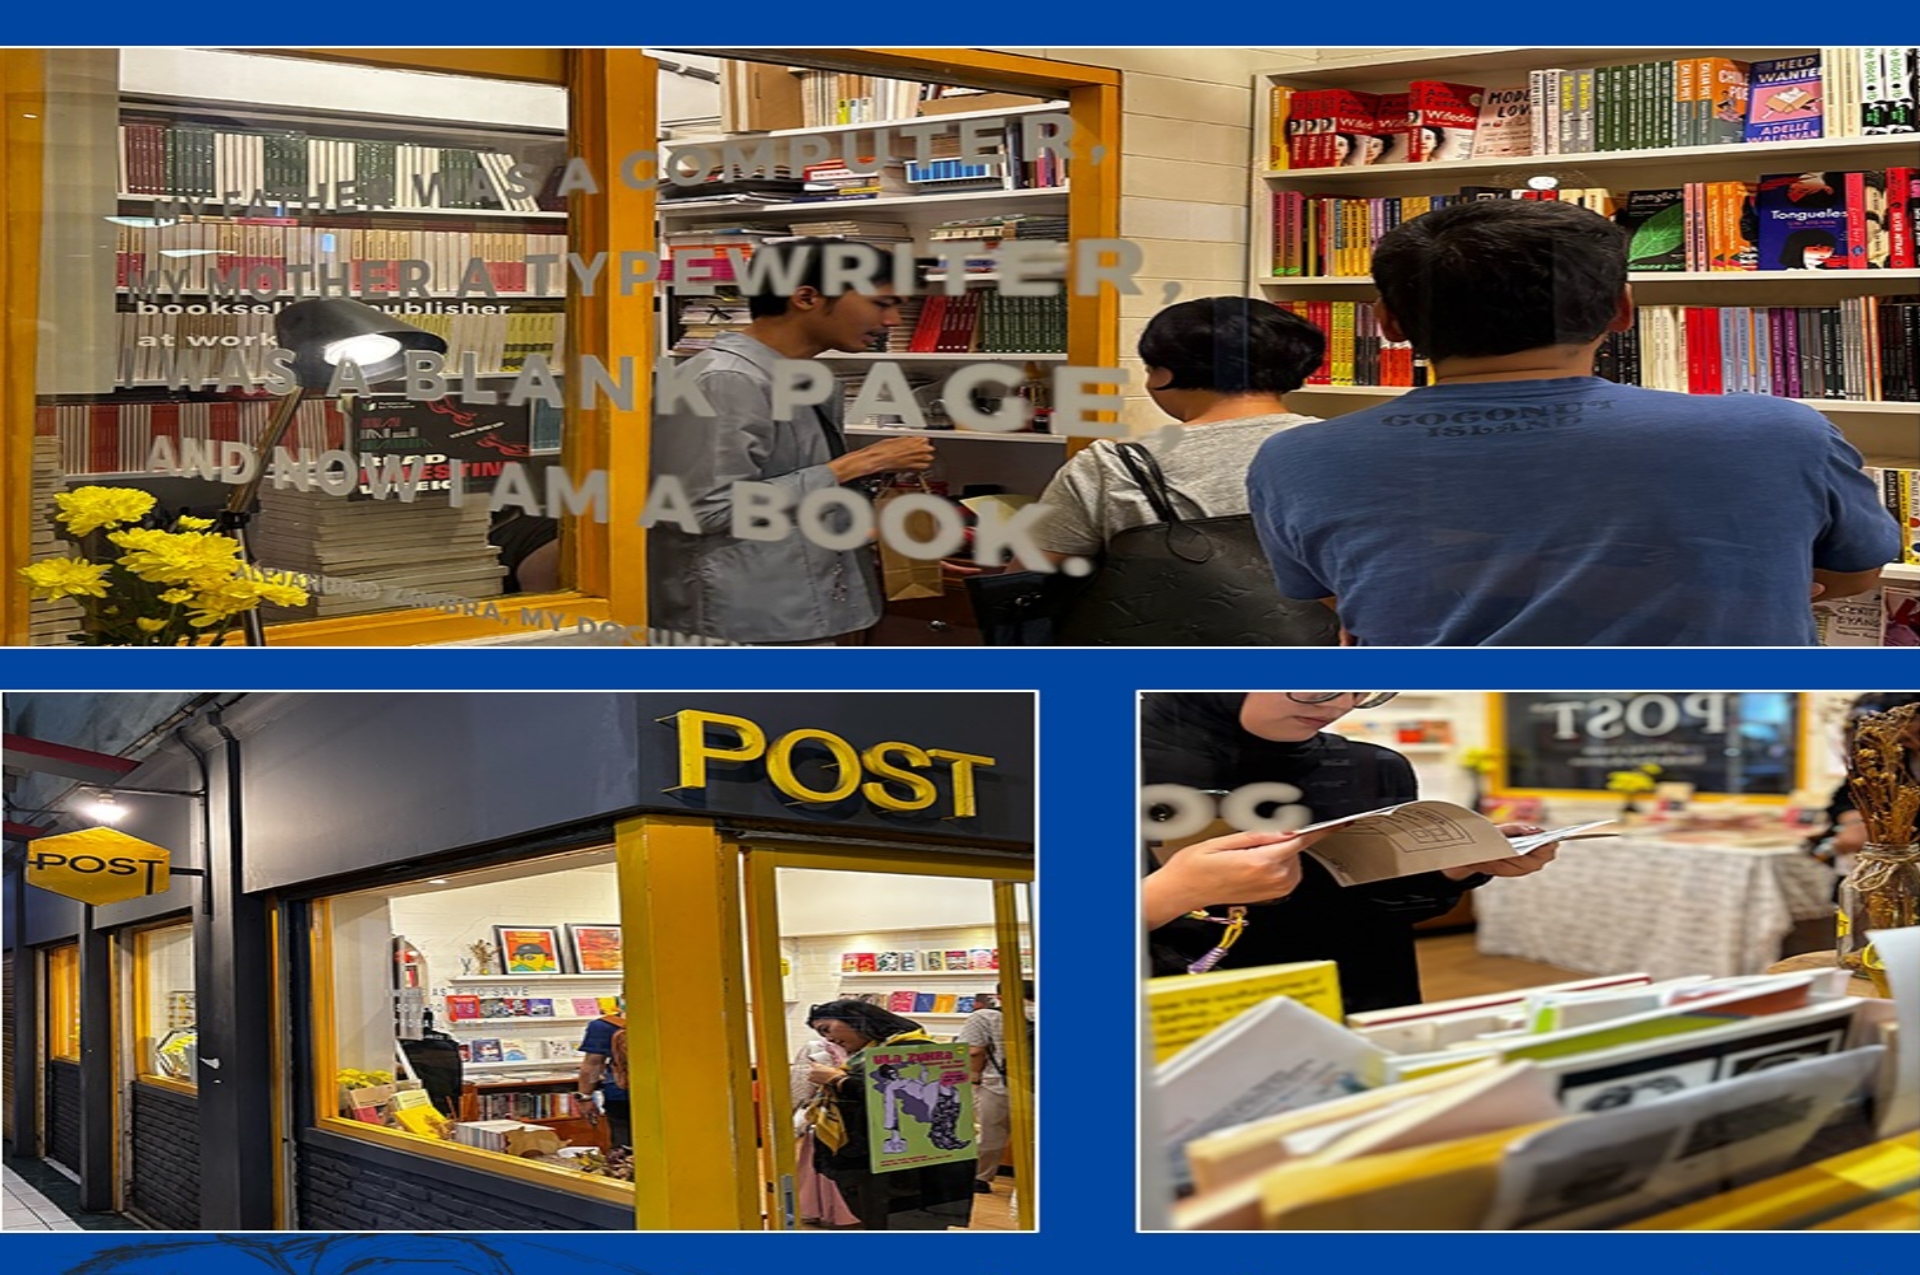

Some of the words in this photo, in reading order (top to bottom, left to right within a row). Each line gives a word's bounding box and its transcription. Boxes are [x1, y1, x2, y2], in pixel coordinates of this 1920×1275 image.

[1775, 57, 1816, 70] HELP
[1758, 67, 1822, 83] WANTE
[1487, 89, 1531, 105] MODE
[1497, 104, 1532, 118] LOV
[1761, 122, 1811, 136] ADELLE
[558, 155, 600, 196] A
[619, 112, 1108, 191] COMPUTER,
[1770, 208, 1848, 221] Tongueles
[127, 268, 190, 302] MY
[208, 258, 430, 302] MOTHER
[458, 256, 498, 301] A
[525, 238, 1183, 303] TYPEWRITER,
[136, 300, 293, 315] booksel
[137, 333, 175, 347] at
[187, 332, 279, 347] work
[150, 347, 298, 397] WAS
[328, 350, 372, 400] A
[405, 348, 718, 418] BLANK
[770, 359, 1187, 452] PAGE,
[360, 453, 448, 467] RAD
[144, 433, 257, 485] AND
[272, 446, 424, 504] NOW
[448, 458, 462, 509] I
[486, 464, 611, 525] AM
[638, 473, 702, 535] A
[730, 480, 1097, 578] BOOK.
[521, 606, 566, 632] MY
[676, 709, 996, 819] POST
[30, 852, 165, 895] POST
